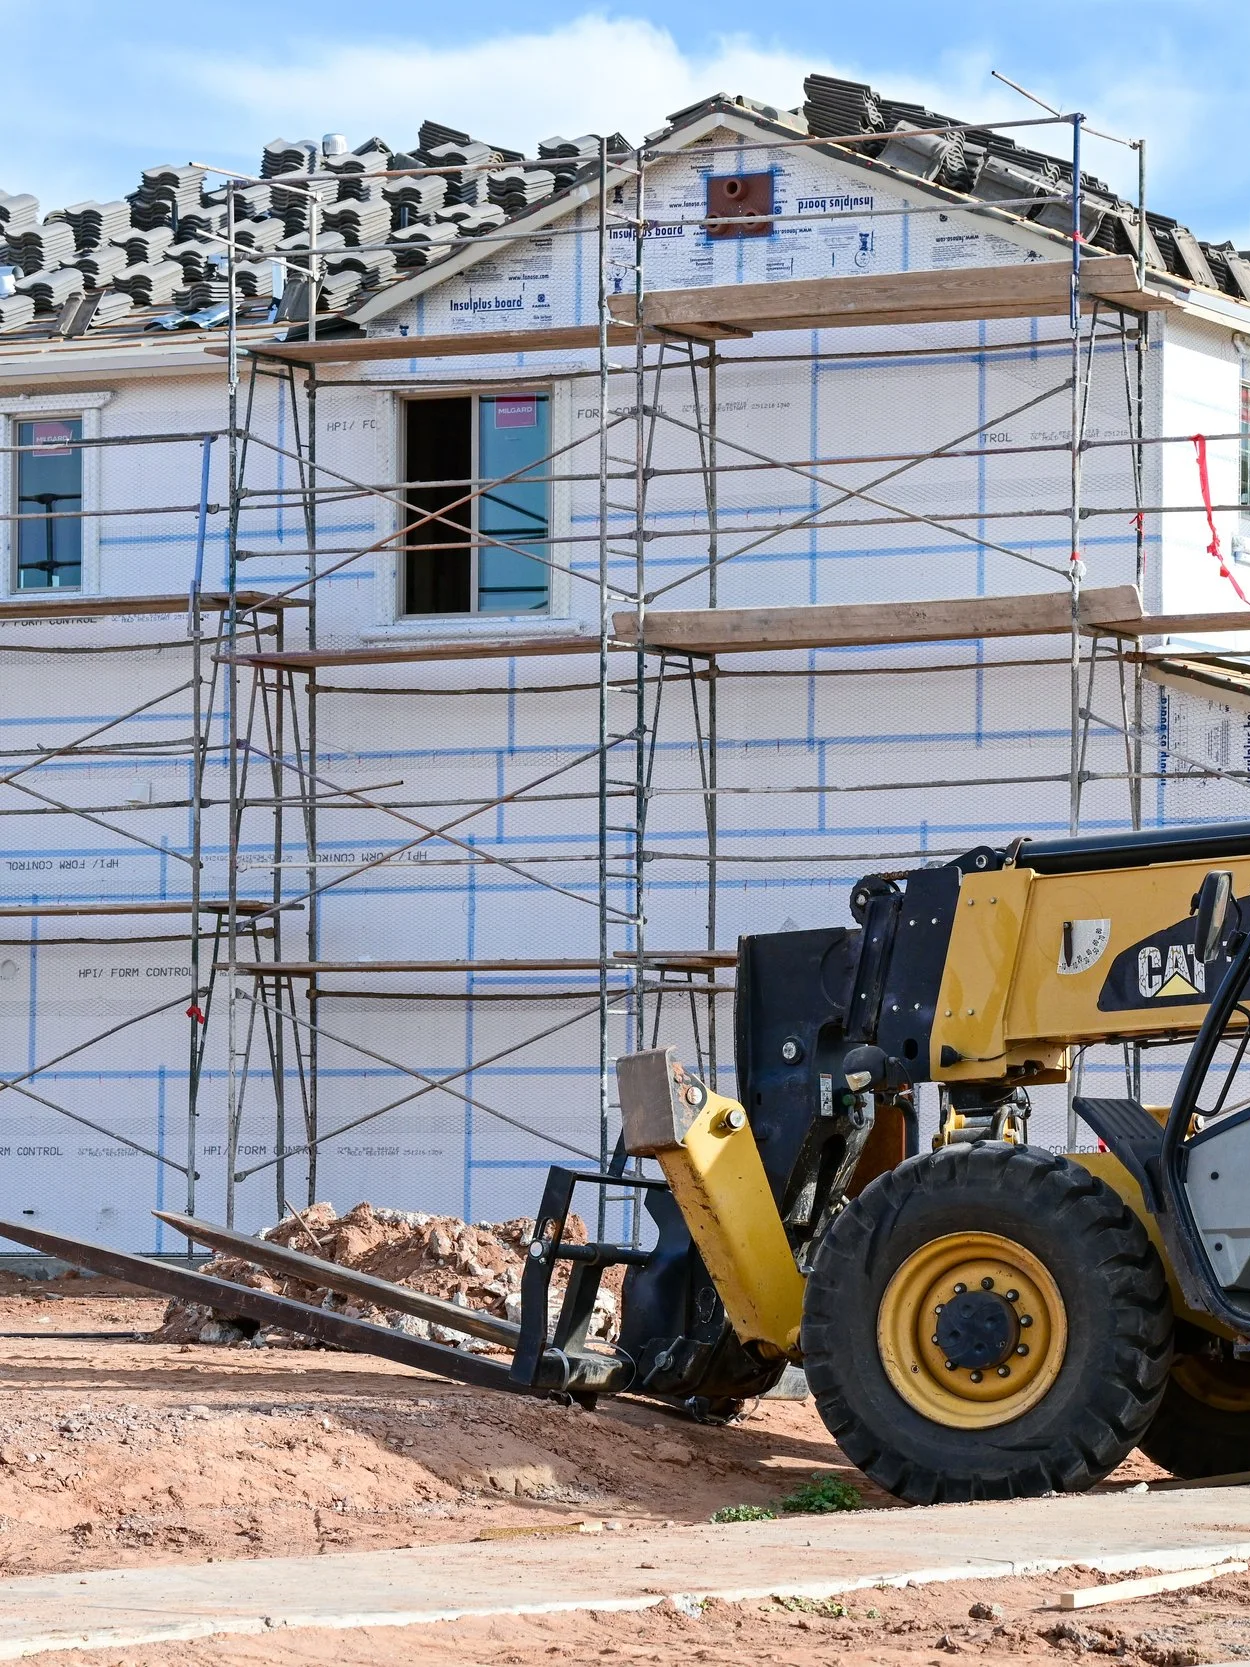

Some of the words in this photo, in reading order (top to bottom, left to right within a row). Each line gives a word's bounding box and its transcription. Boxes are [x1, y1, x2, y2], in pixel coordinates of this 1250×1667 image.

[798, 199, 826, 213] board
[830, 195, 874, 211] Insulplus
[656, 223, 683, 237] board
[450, 297, 492, 314] Insulplus
[495, 295, 522, 308] board
[498, 406, 533, 414] MILGARD
[577, 408, 600, 420] FOR
[6, 860, 53, 871] CONTROL
[59, 859, 86, 870] FORM
[78, 967, 104, 979] HPI/
[111, 967, 140, 978] FORM
[146, 966, 193, 978] CONTROL
[1138, 944, 1206, 998] CAT
[16, 1146, 63, 1157] CONTROL
[237, 1145, 267, 1156] FORM
